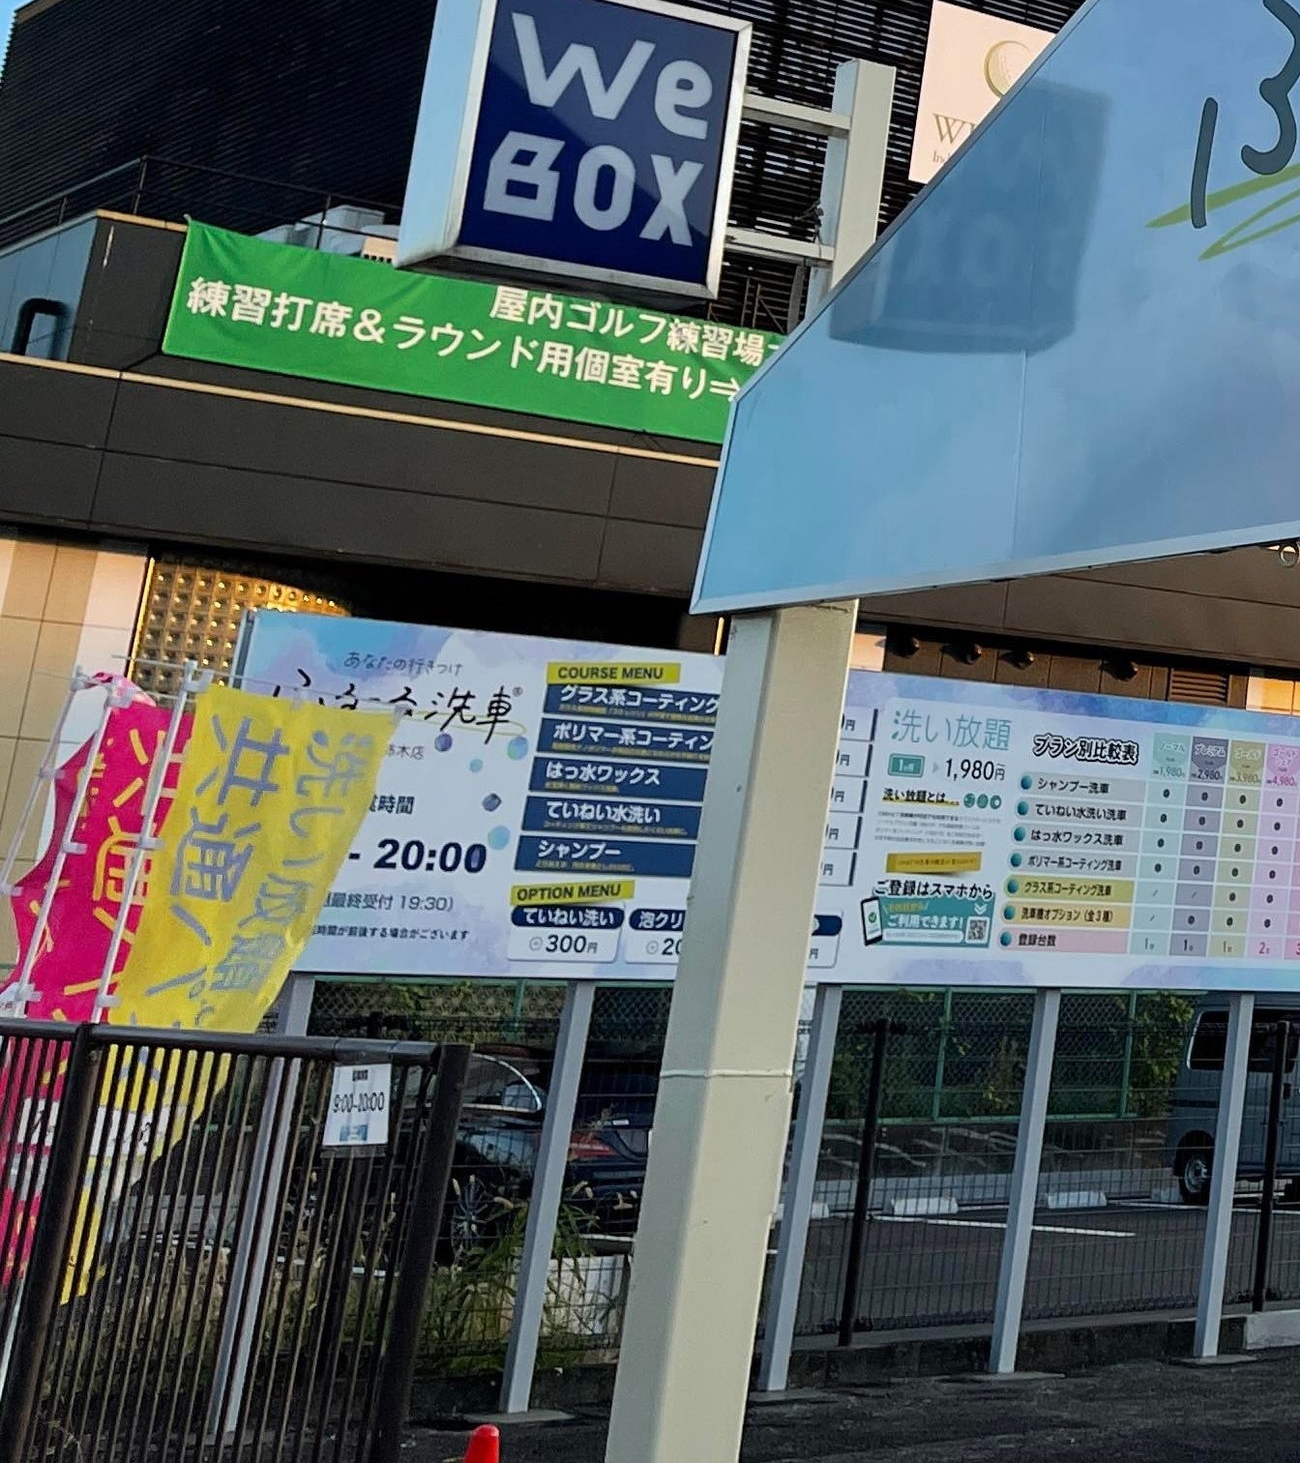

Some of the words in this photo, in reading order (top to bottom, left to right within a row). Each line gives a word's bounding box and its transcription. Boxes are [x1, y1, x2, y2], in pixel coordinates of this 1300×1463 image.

[511, 12, 713, 140] We
[483, 130, 704, 247] BOX
[489, 286, 783, 366] 屋内ゴルフ練習場
[344, 652, 463, 676] あなたの行きつけ
[558, 667, 618, 679] COURSE
[622, 667, 664, 680] MENU
[891, 708, 1012, 750] 洗い放題
[1032, 733, 1140, 764] プラン別比較表
[546, 760, 661, 785] はっ水ワックス
[1037, 777, 1109, 794] シャンプー洗車
[546, 800, 661, 823] ていねい水洗い
[373, 838, 487, 873] 20:00
[538, 840, 621, 860] シャンプー
[517, 888, 573, 902] OPTION
[578, 884, 621, 898] MENU
[875, 879, 993, 900] ご登録はスマホから
[523, 908, 614, 926] ていねい洗い
